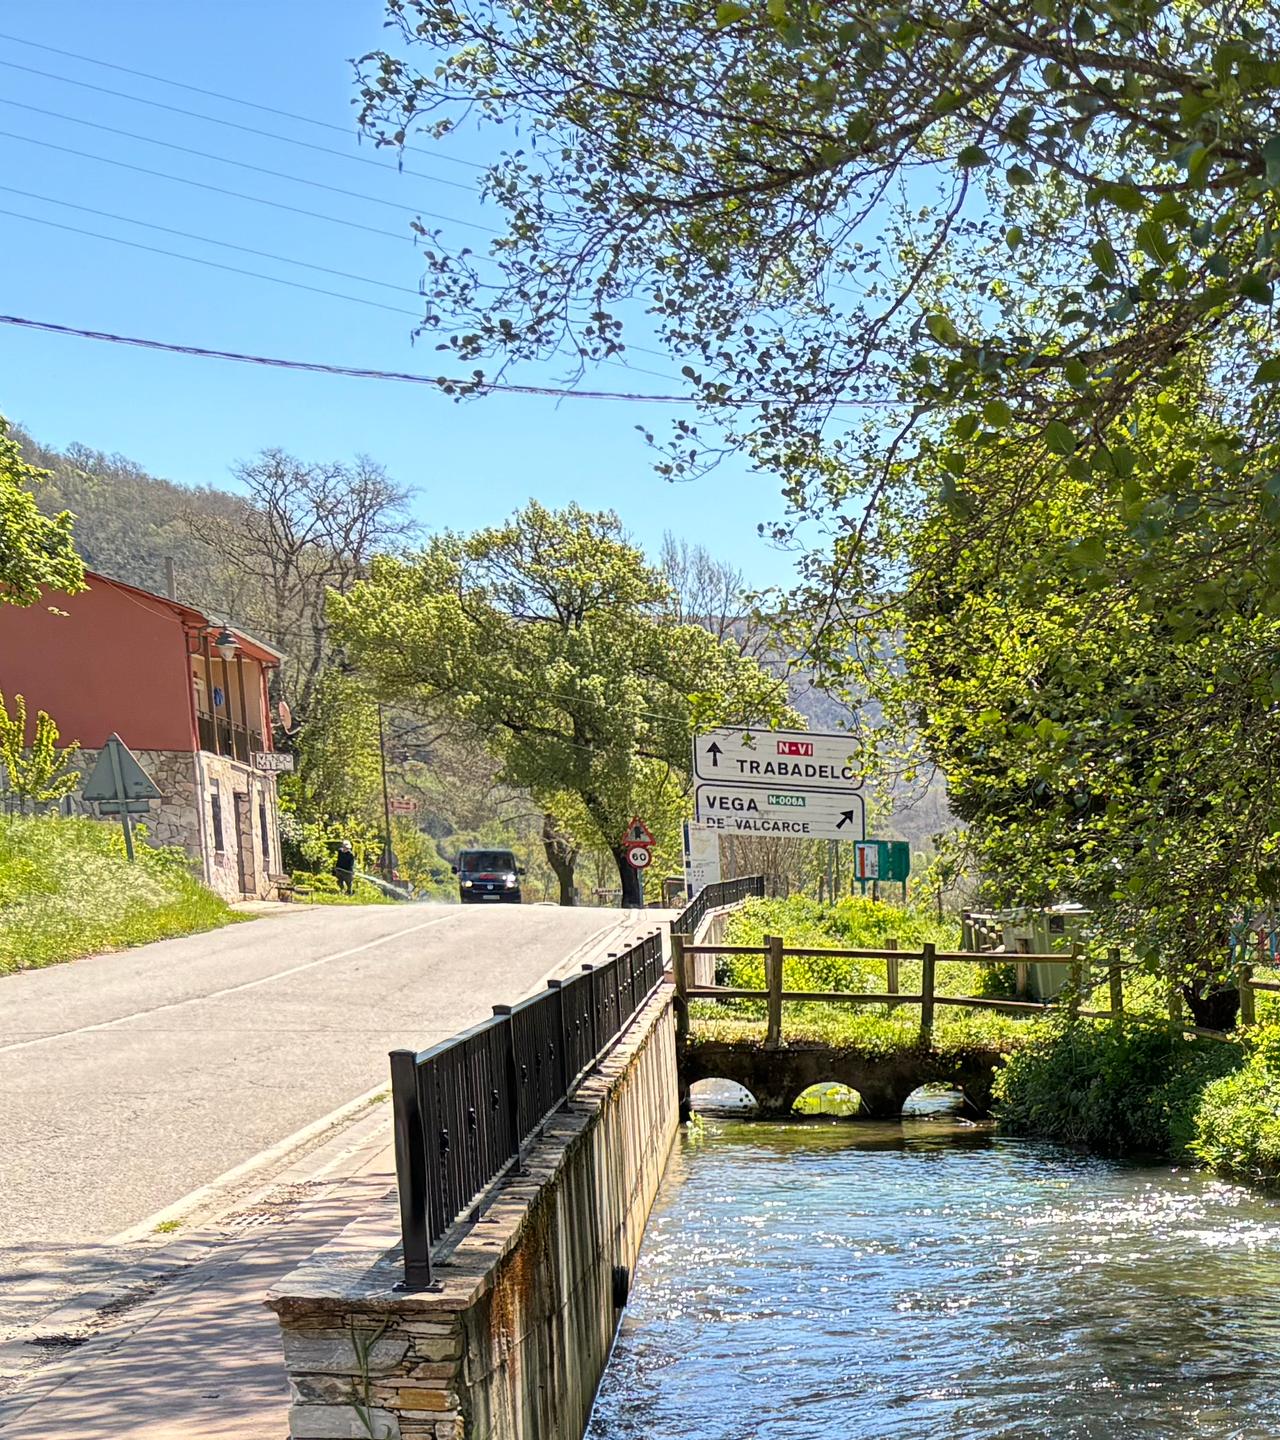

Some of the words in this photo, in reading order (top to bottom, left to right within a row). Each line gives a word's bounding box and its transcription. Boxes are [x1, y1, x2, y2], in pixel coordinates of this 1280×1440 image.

[778, 742, 812, 755] N-VI
[706, 795, 759, 812] VEGA
[706, 817, 725, 829] DE
[735, 819, 810, 833] VALCARCE
[632, 853, 646, 861] 60
